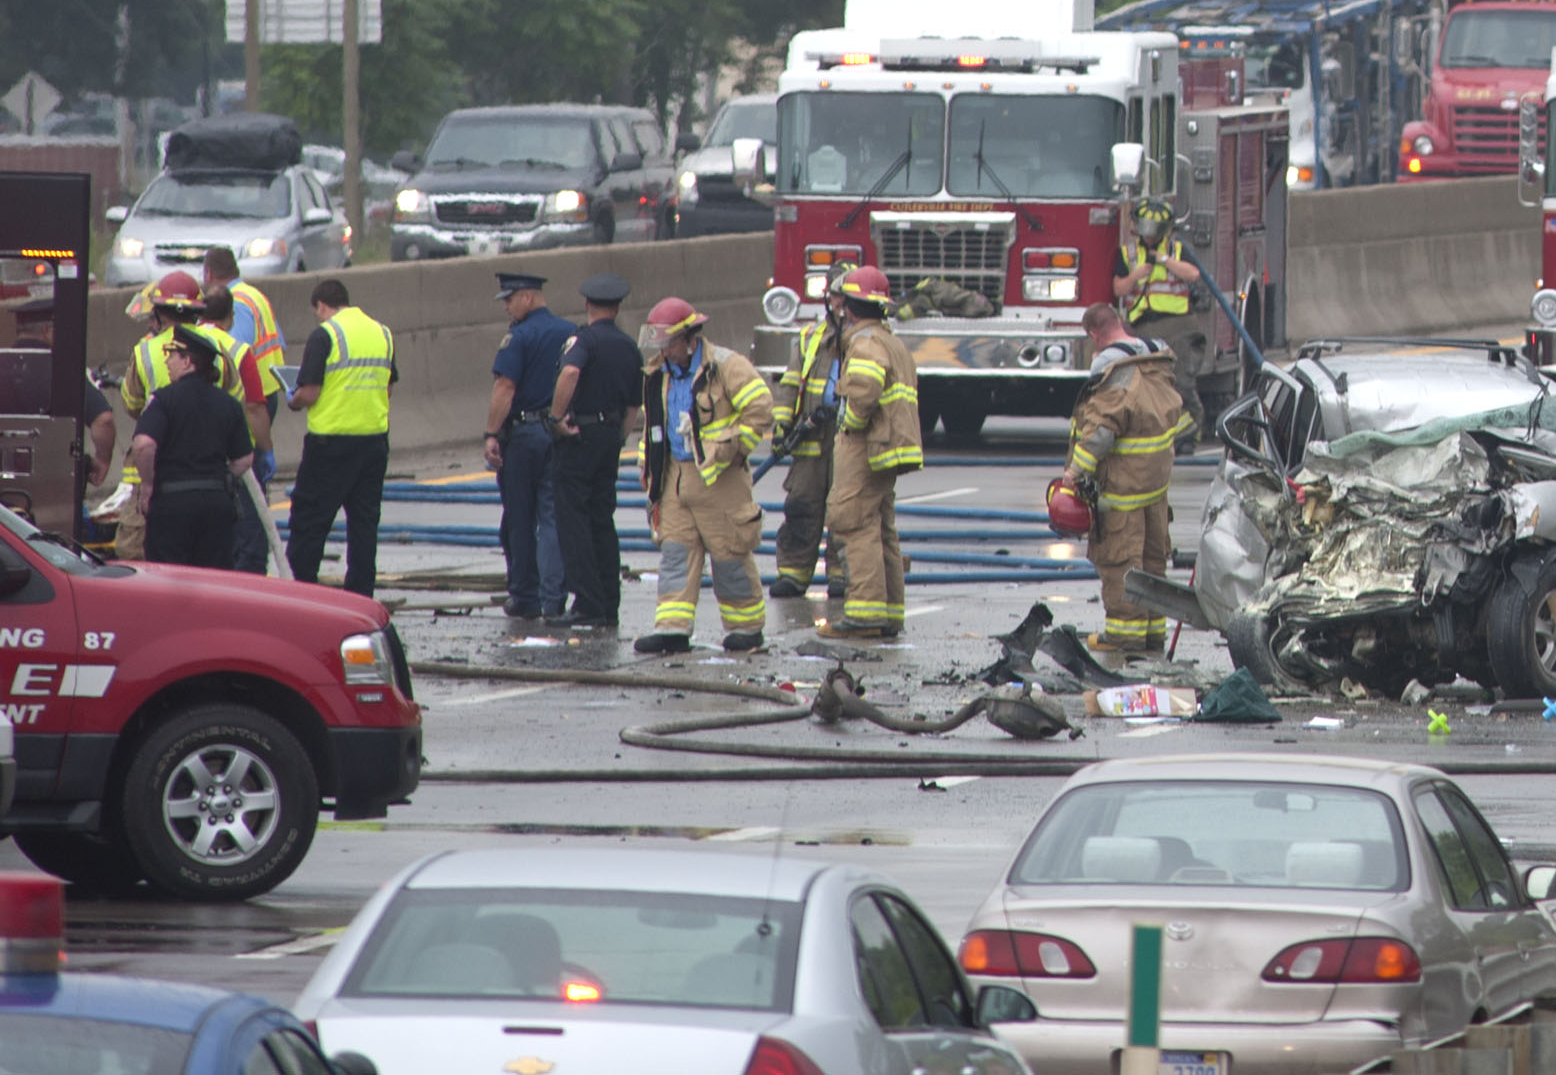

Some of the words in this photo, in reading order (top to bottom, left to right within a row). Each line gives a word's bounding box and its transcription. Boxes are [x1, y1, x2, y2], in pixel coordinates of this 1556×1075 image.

[84, 632, 115, 650] 87
[10, 663, 58, 696] E
[0, 704, 46, 724] NT
